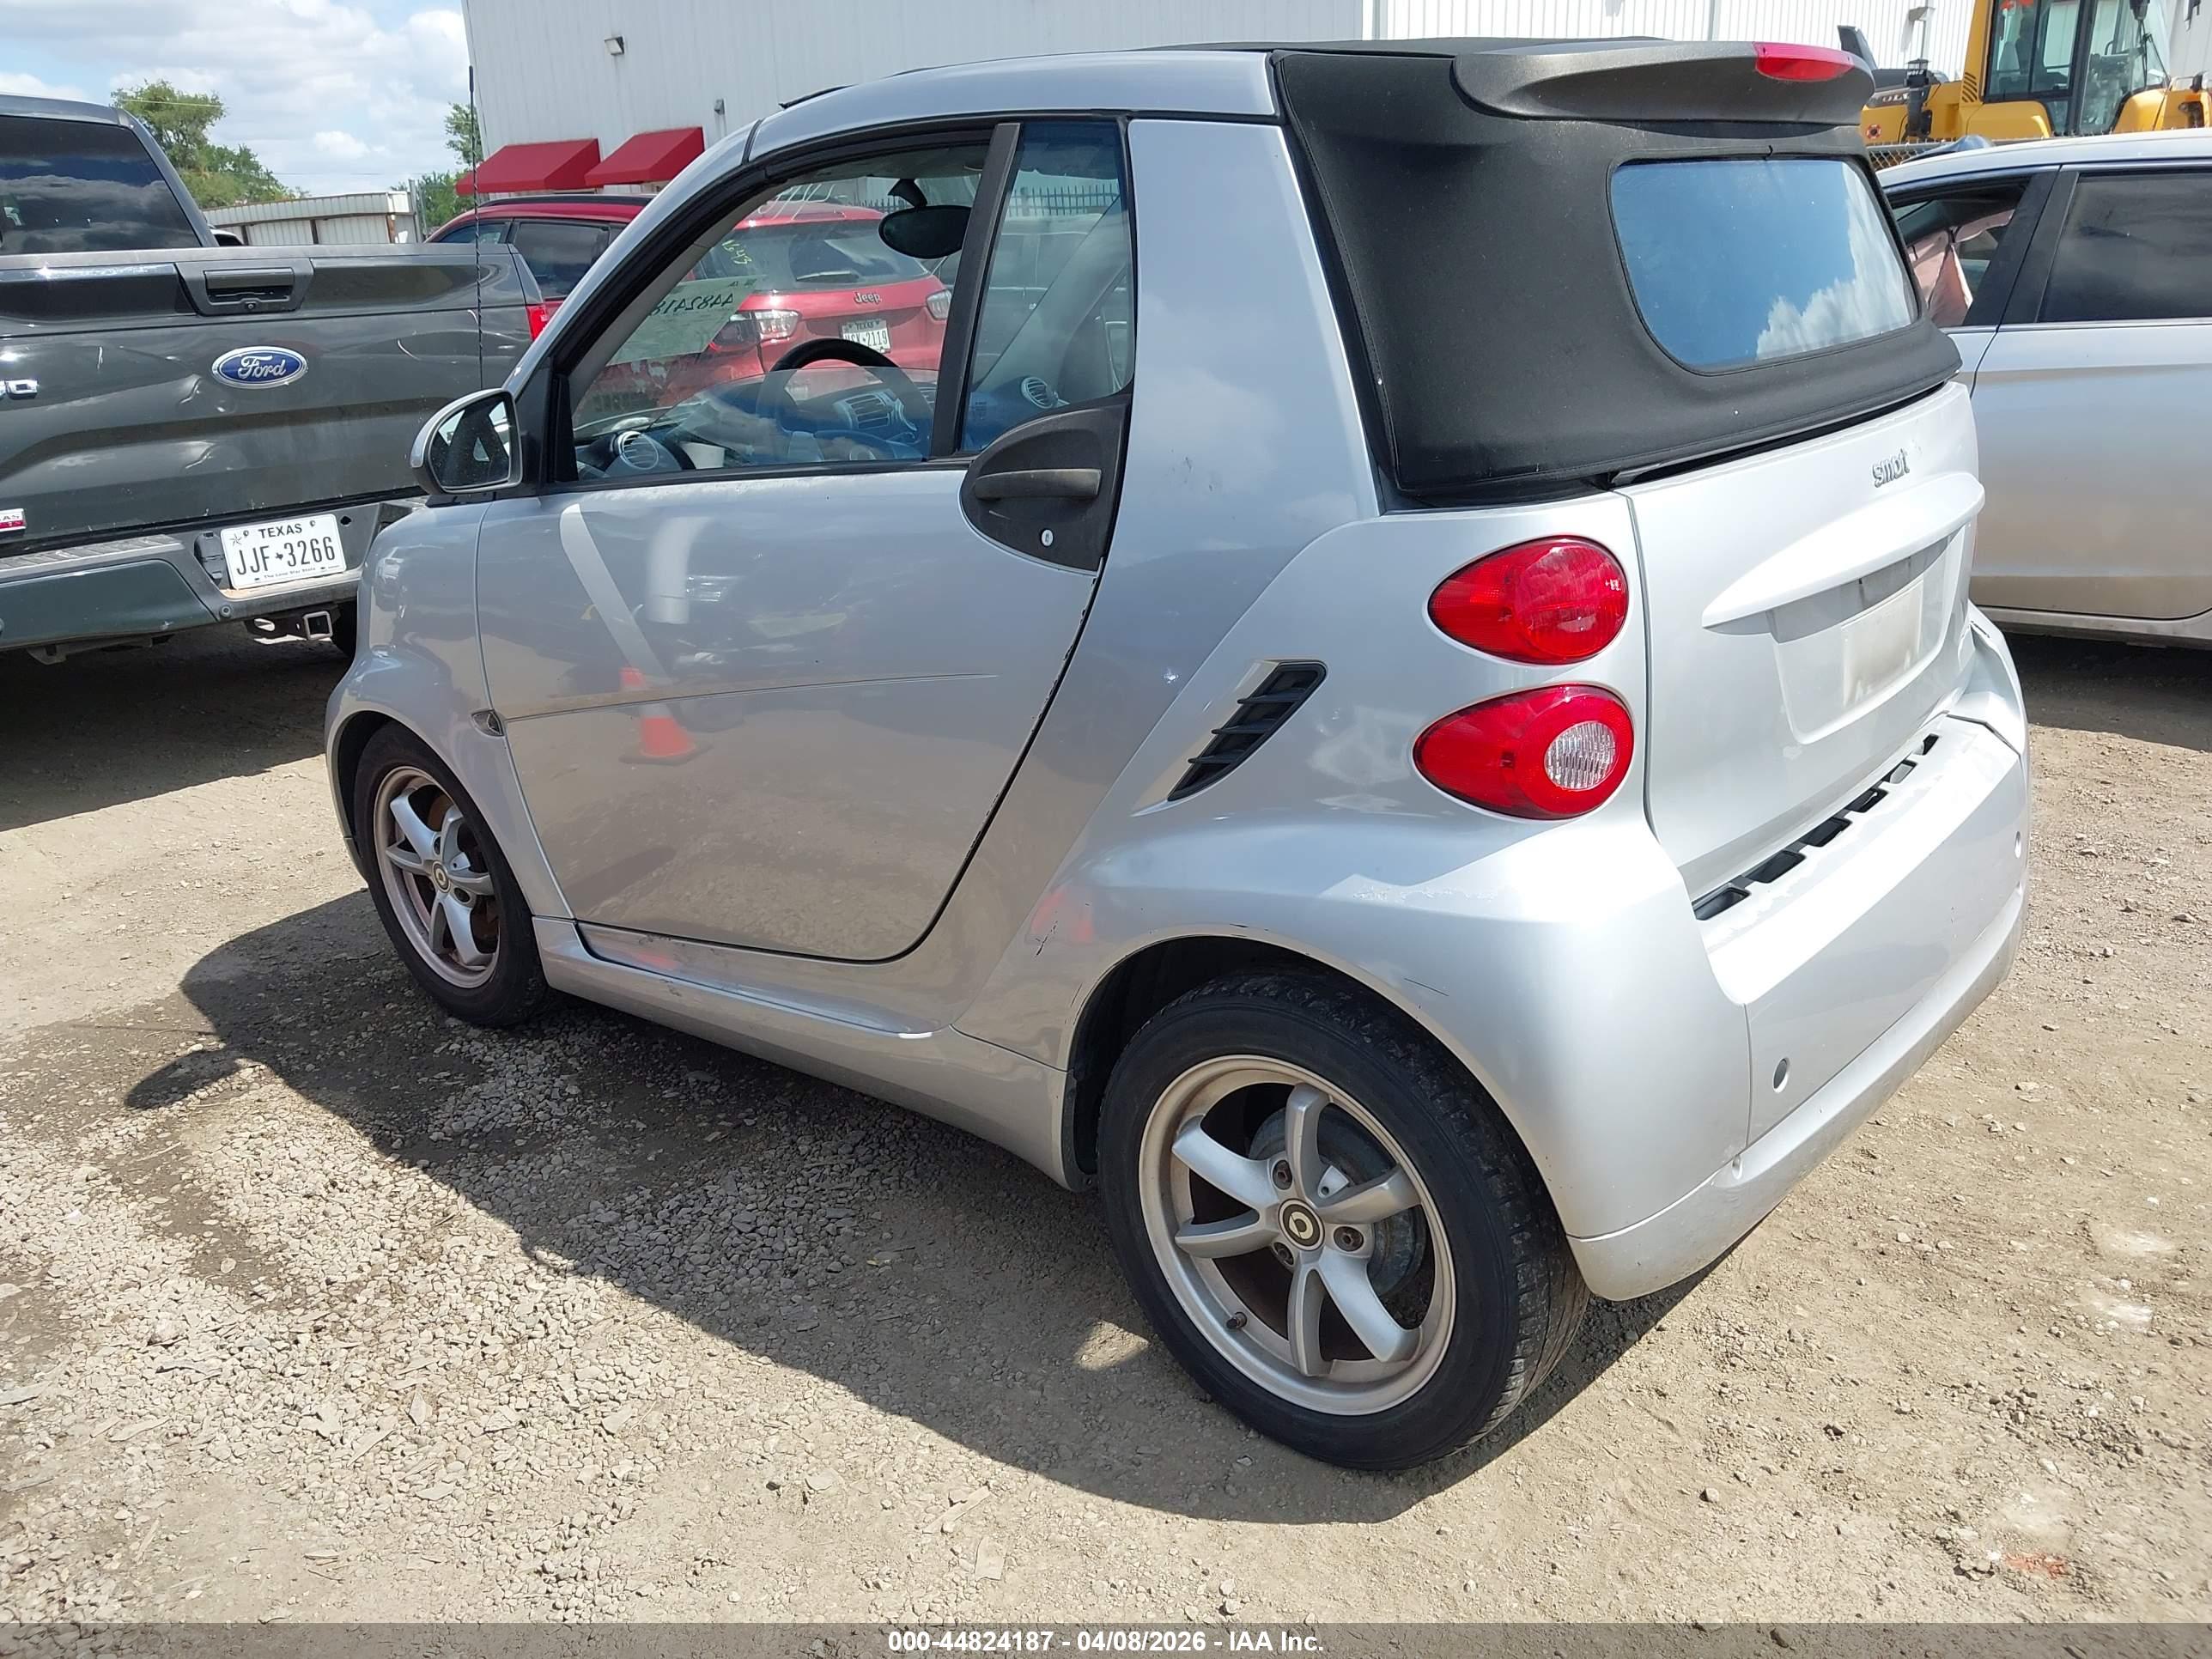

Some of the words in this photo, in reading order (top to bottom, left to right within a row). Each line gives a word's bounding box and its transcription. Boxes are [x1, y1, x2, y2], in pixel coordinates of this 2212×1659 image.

[854, 291, 881, 304] Jeep
[237, 355, 286, 379] Ford
[258, 523, 303, 539] TEXAS
